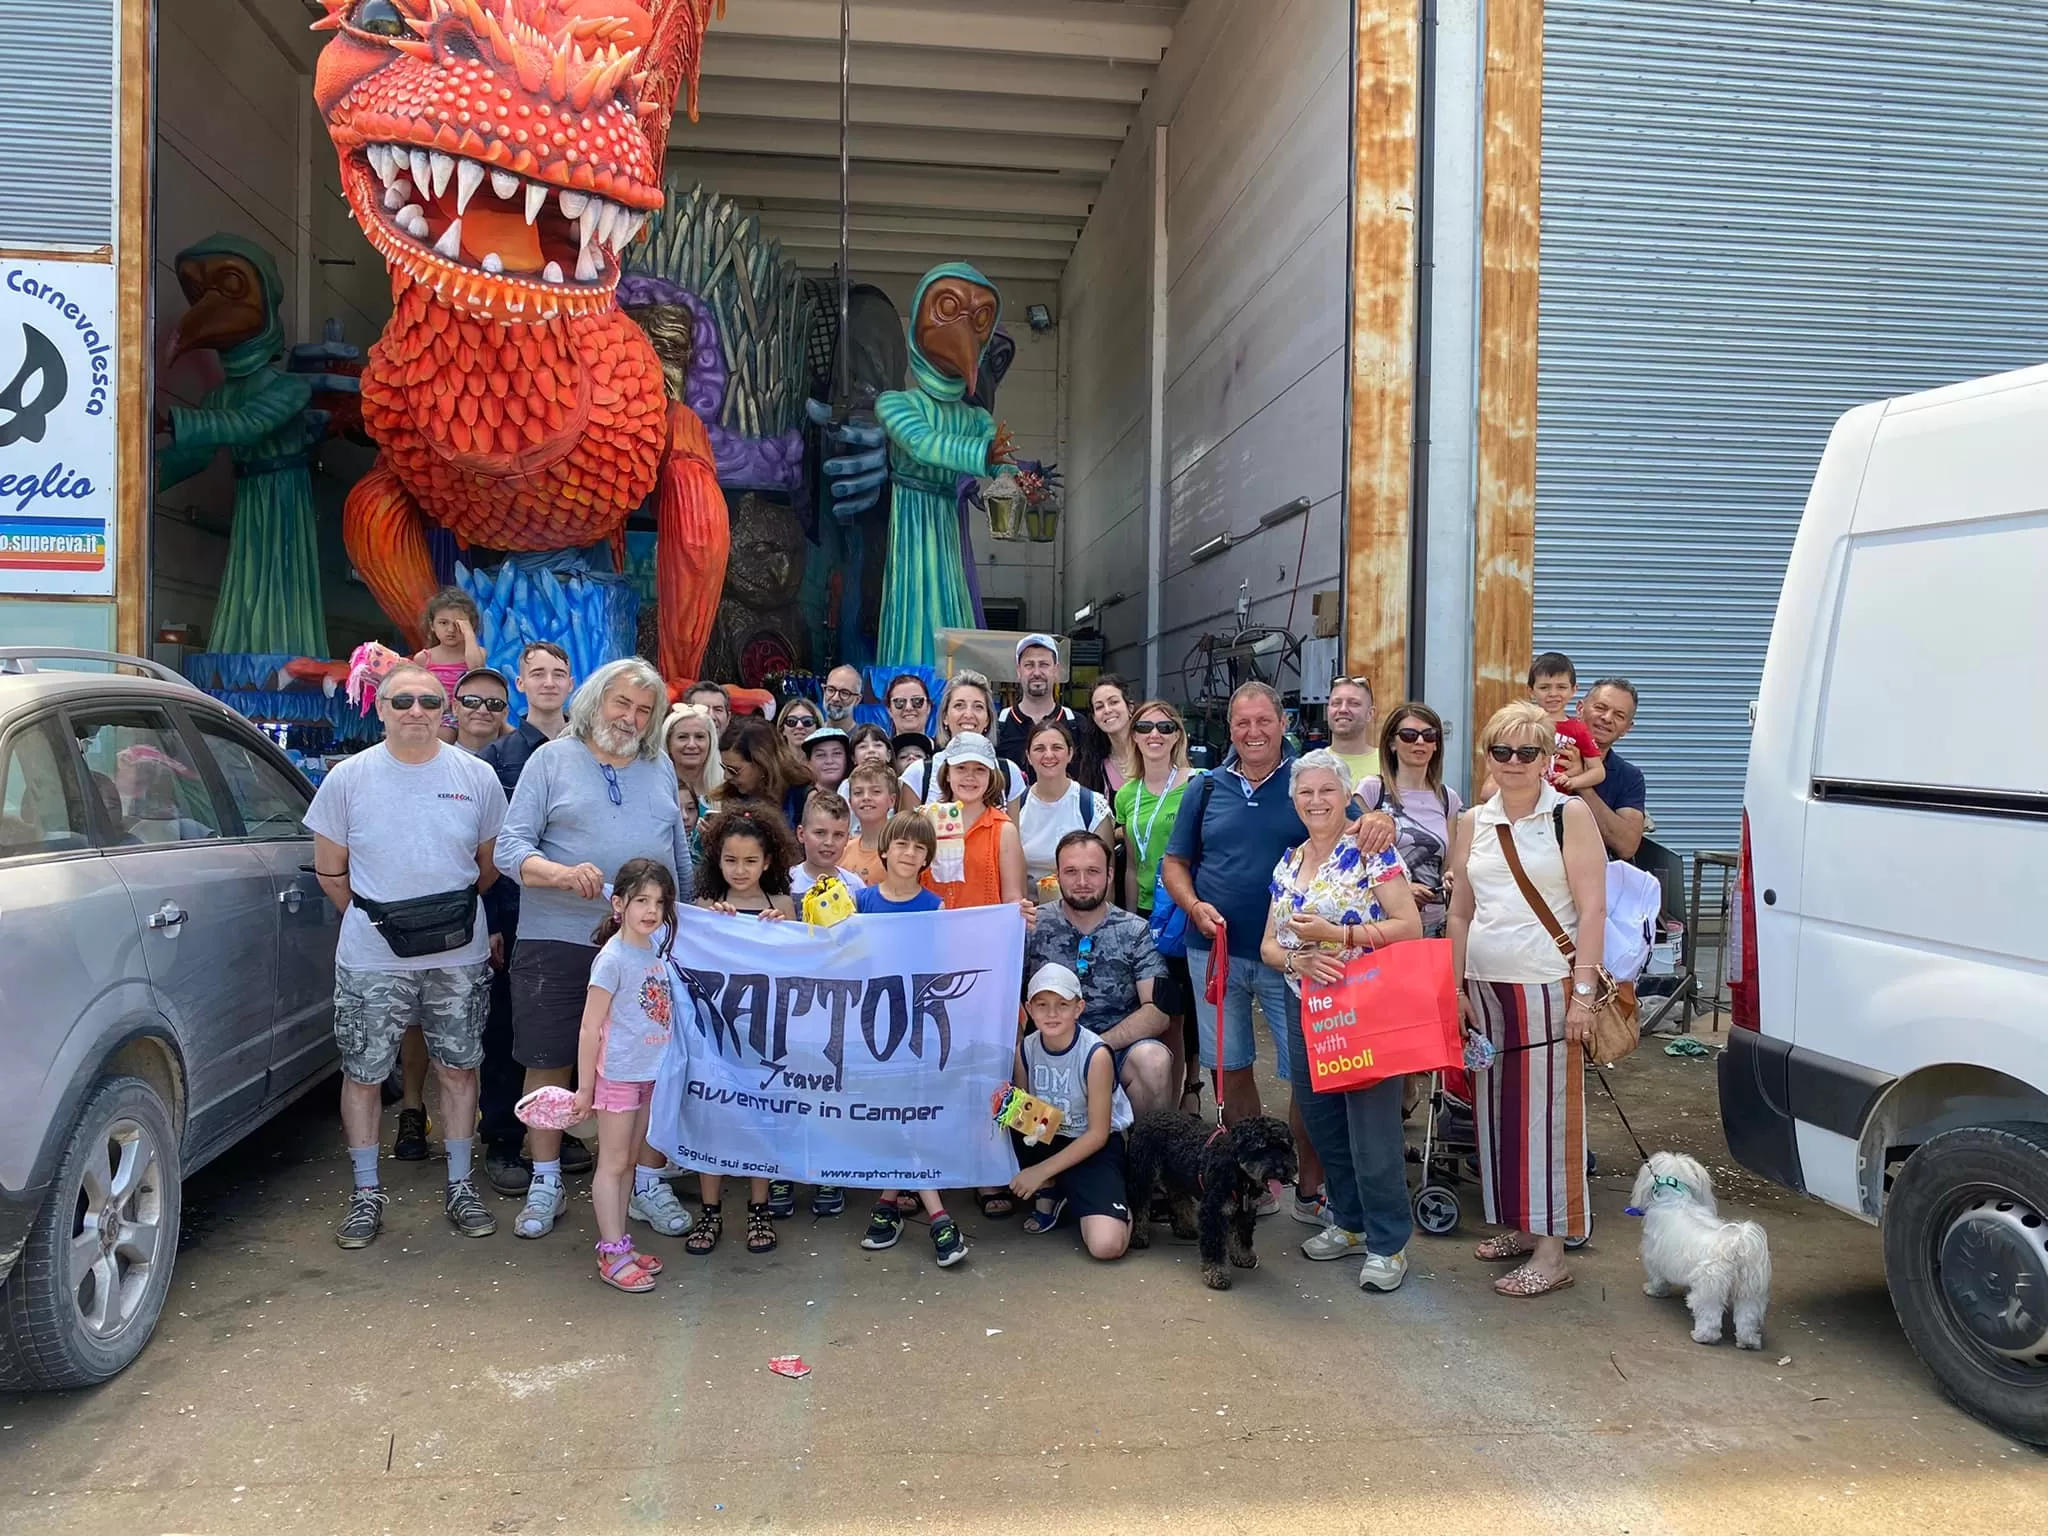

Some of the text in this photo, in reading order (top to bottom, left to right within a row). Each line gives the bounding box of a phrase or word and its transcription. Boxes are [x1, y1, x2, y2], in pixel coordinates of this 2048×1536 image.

[7, 269, 110, 416] Carnevalesca
[1308, 996, 1333, 1014] the
[679, 969, 993, 1072] RAPTOR
[1312, 1008, 1357, 1033] world
[1313, 1033, 1348, 1055] with
[759, 1059, 843, 1092] Travel
[1317, 1048, 1374, 1077] boboli
[687, 1080, 944, 1125] Avventure in Camper
[678, 1145, 779, 1174] Seguici sui social
[820, 1168, 942, 1181] www.raptortravel.it
